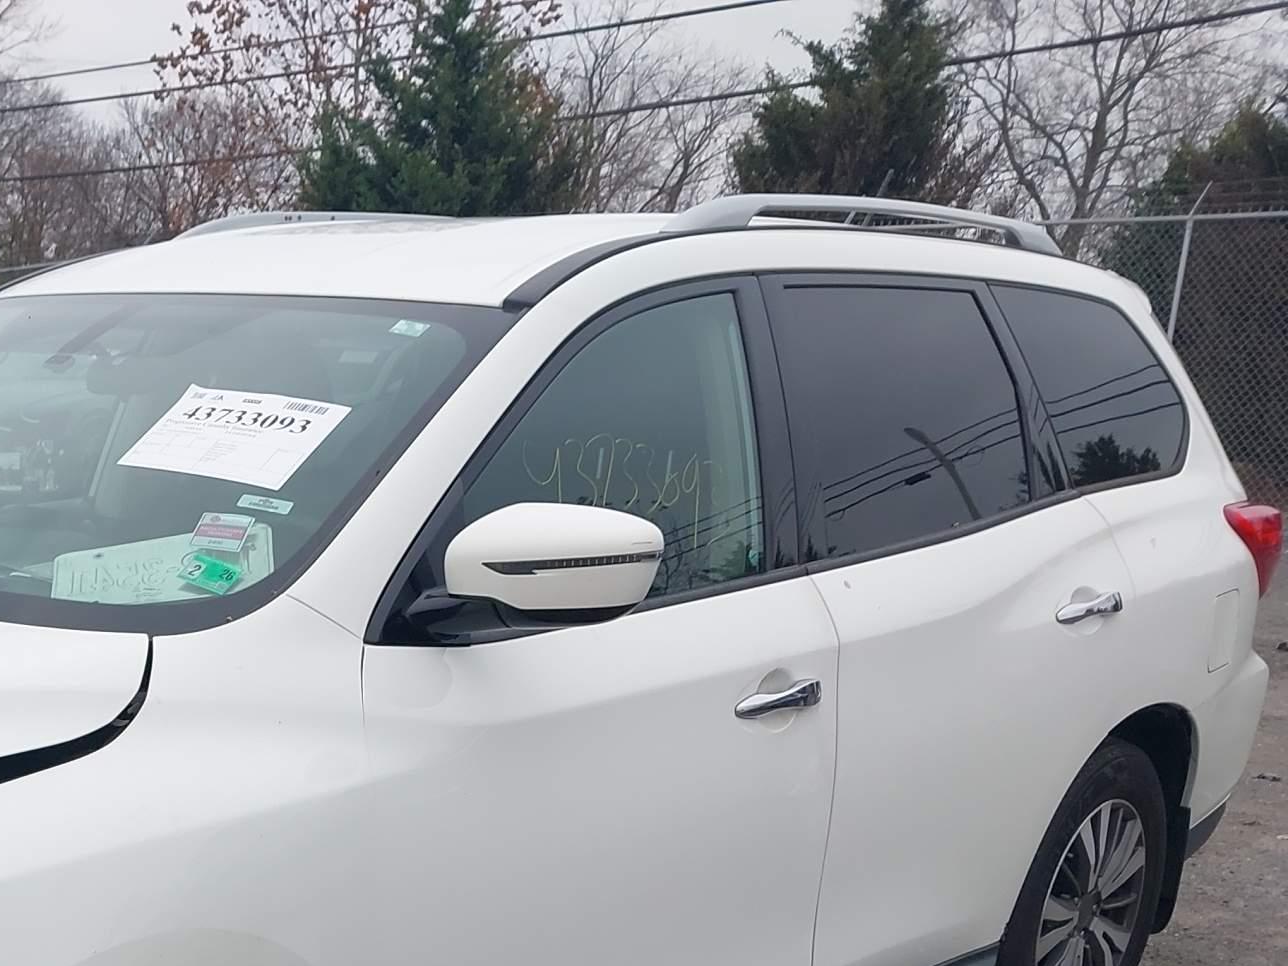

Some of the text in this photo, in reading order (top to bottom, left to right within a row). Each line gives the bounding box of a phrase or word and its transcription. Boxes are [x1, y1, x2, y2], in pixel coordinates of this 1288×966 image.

[182, 405, 312, 434] 43733093
[188, 564, 236, 581] 2 26
